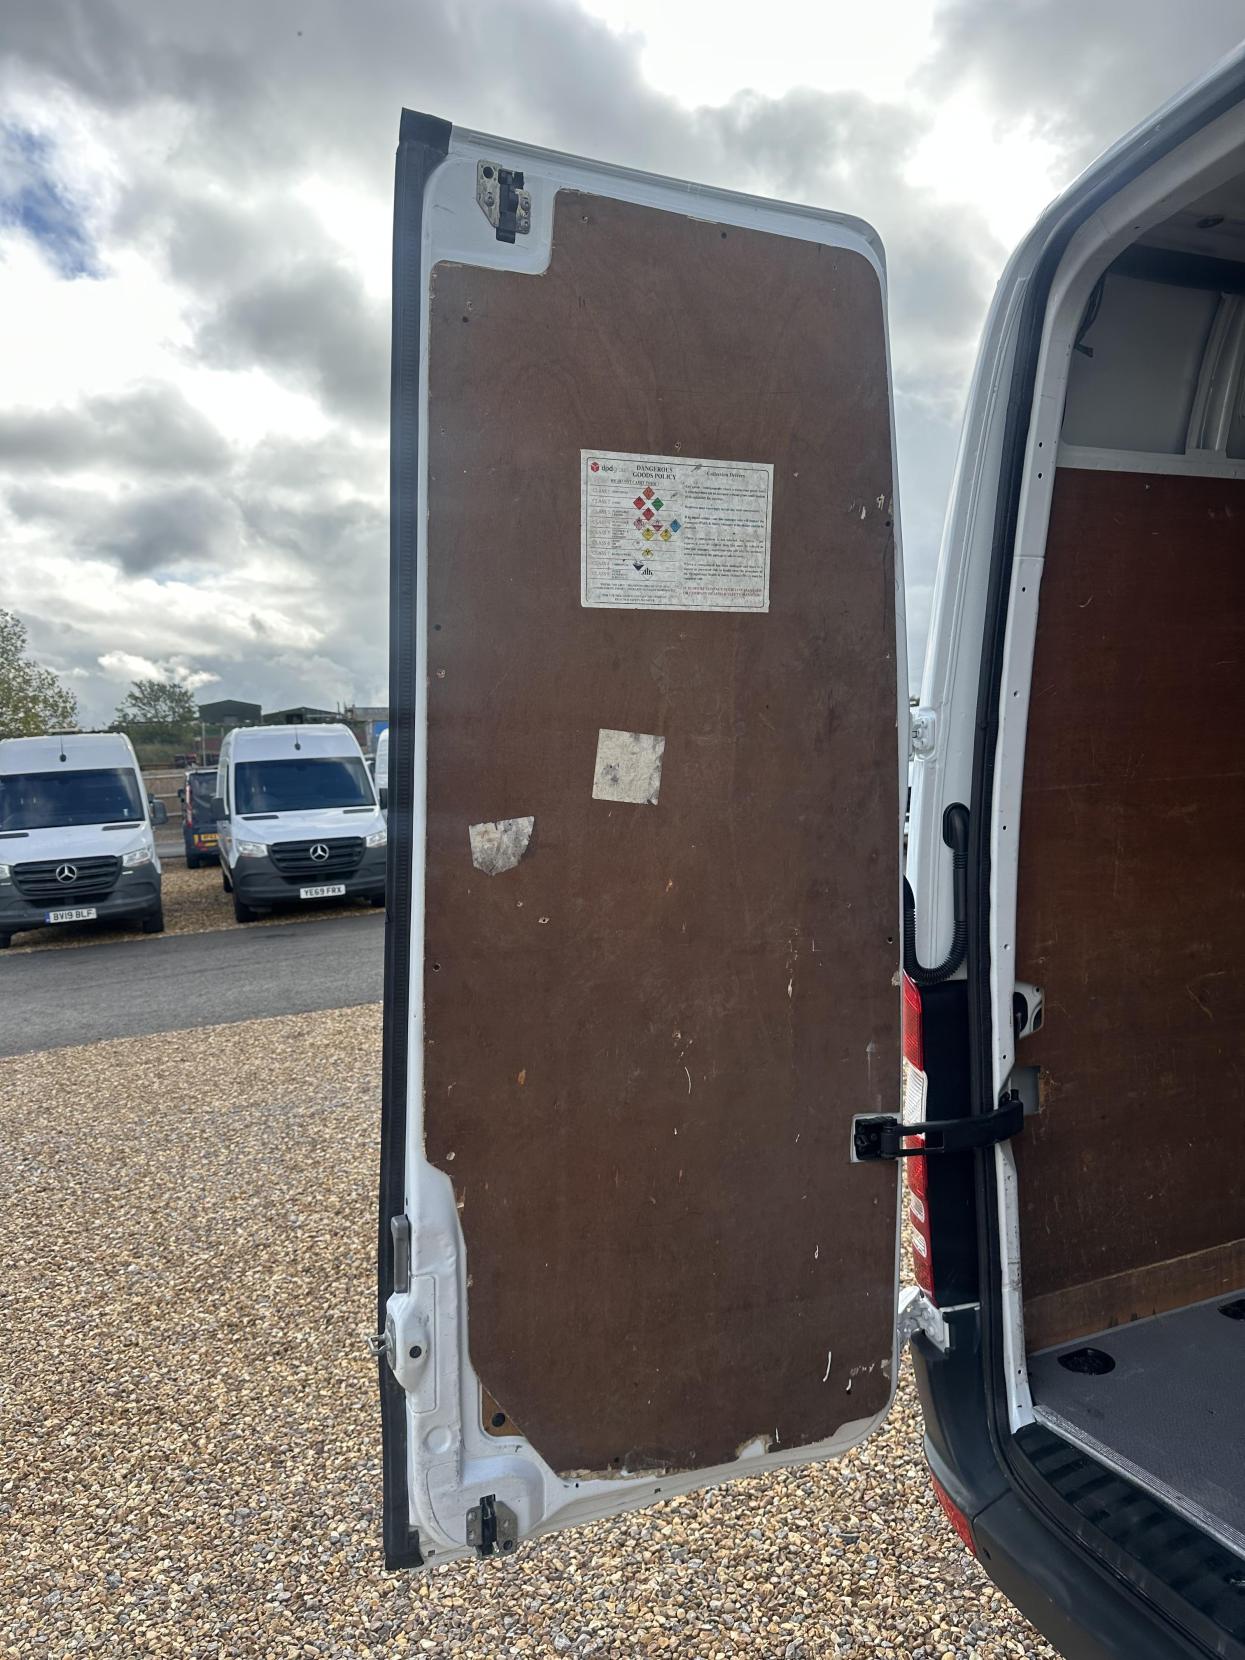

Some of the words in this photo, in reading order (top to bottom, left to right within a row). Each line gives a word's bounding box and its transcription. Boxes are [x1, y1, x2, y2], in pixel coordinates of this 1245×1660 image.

[636, 465, 673, 473] DANGEROUS
[654, 473, 676, 481] POLICY
[304, 887, 325, 896] YE69
[326, 886, 342, 895] FRX
[53, 911, 73, 921] BV19
[75, 909, 94, 919] BLF
